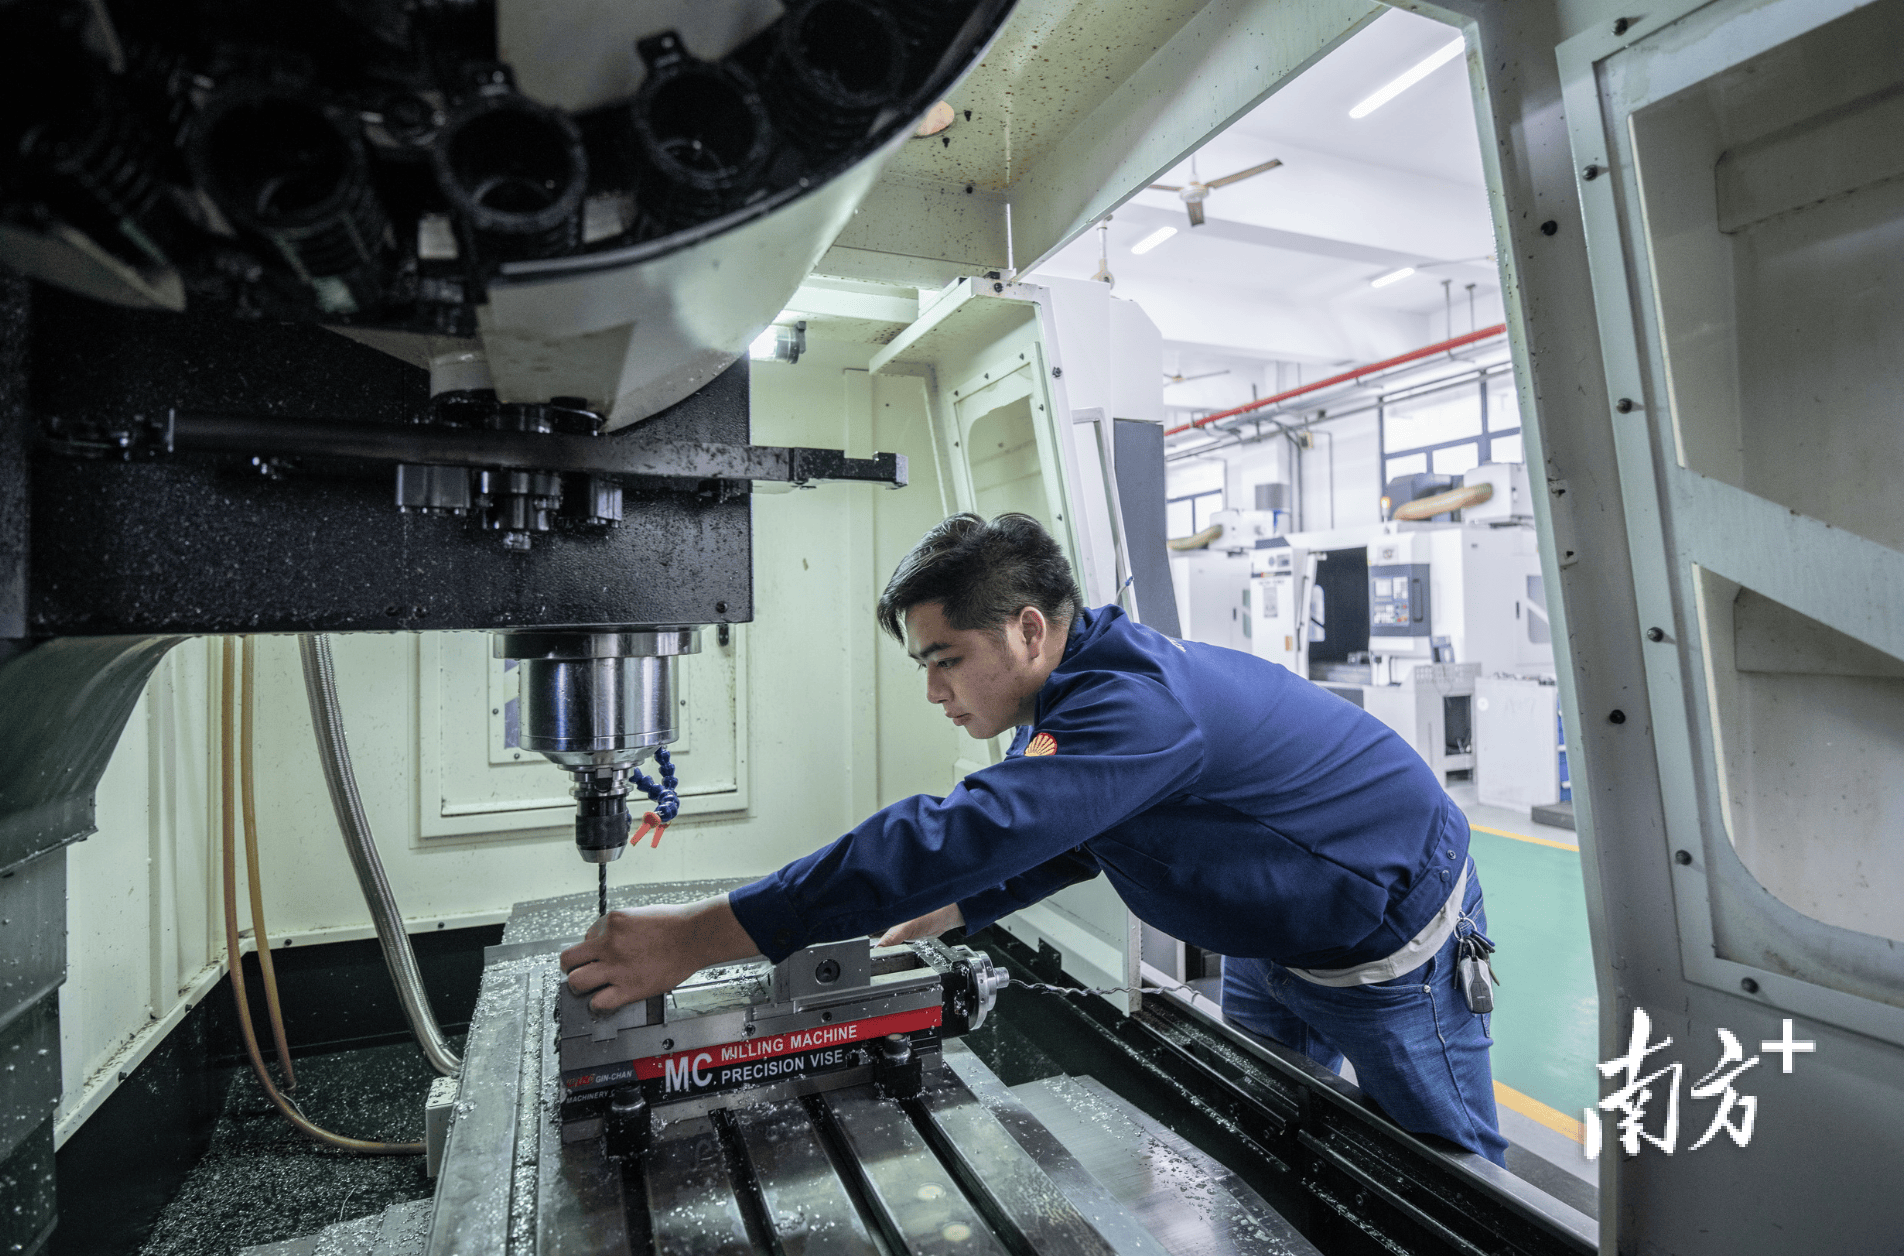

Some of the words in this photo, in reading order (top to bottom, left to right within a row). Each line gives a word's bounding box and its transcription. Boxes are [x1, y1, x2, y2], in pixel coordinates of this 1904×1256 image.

[721, 1038, 783, 1061] MILLING
[790, 1025, 857, 1049] MACHINE
[595, 1070, 633, 1083] GIN-CHAN
[665, 1053, 713, 1093] MC
[721, 1057, 804, 1084] PRECISION
[810, 1049, 843, 1067] VISE
[566, 1090, 609, 1104] MACHINERY
